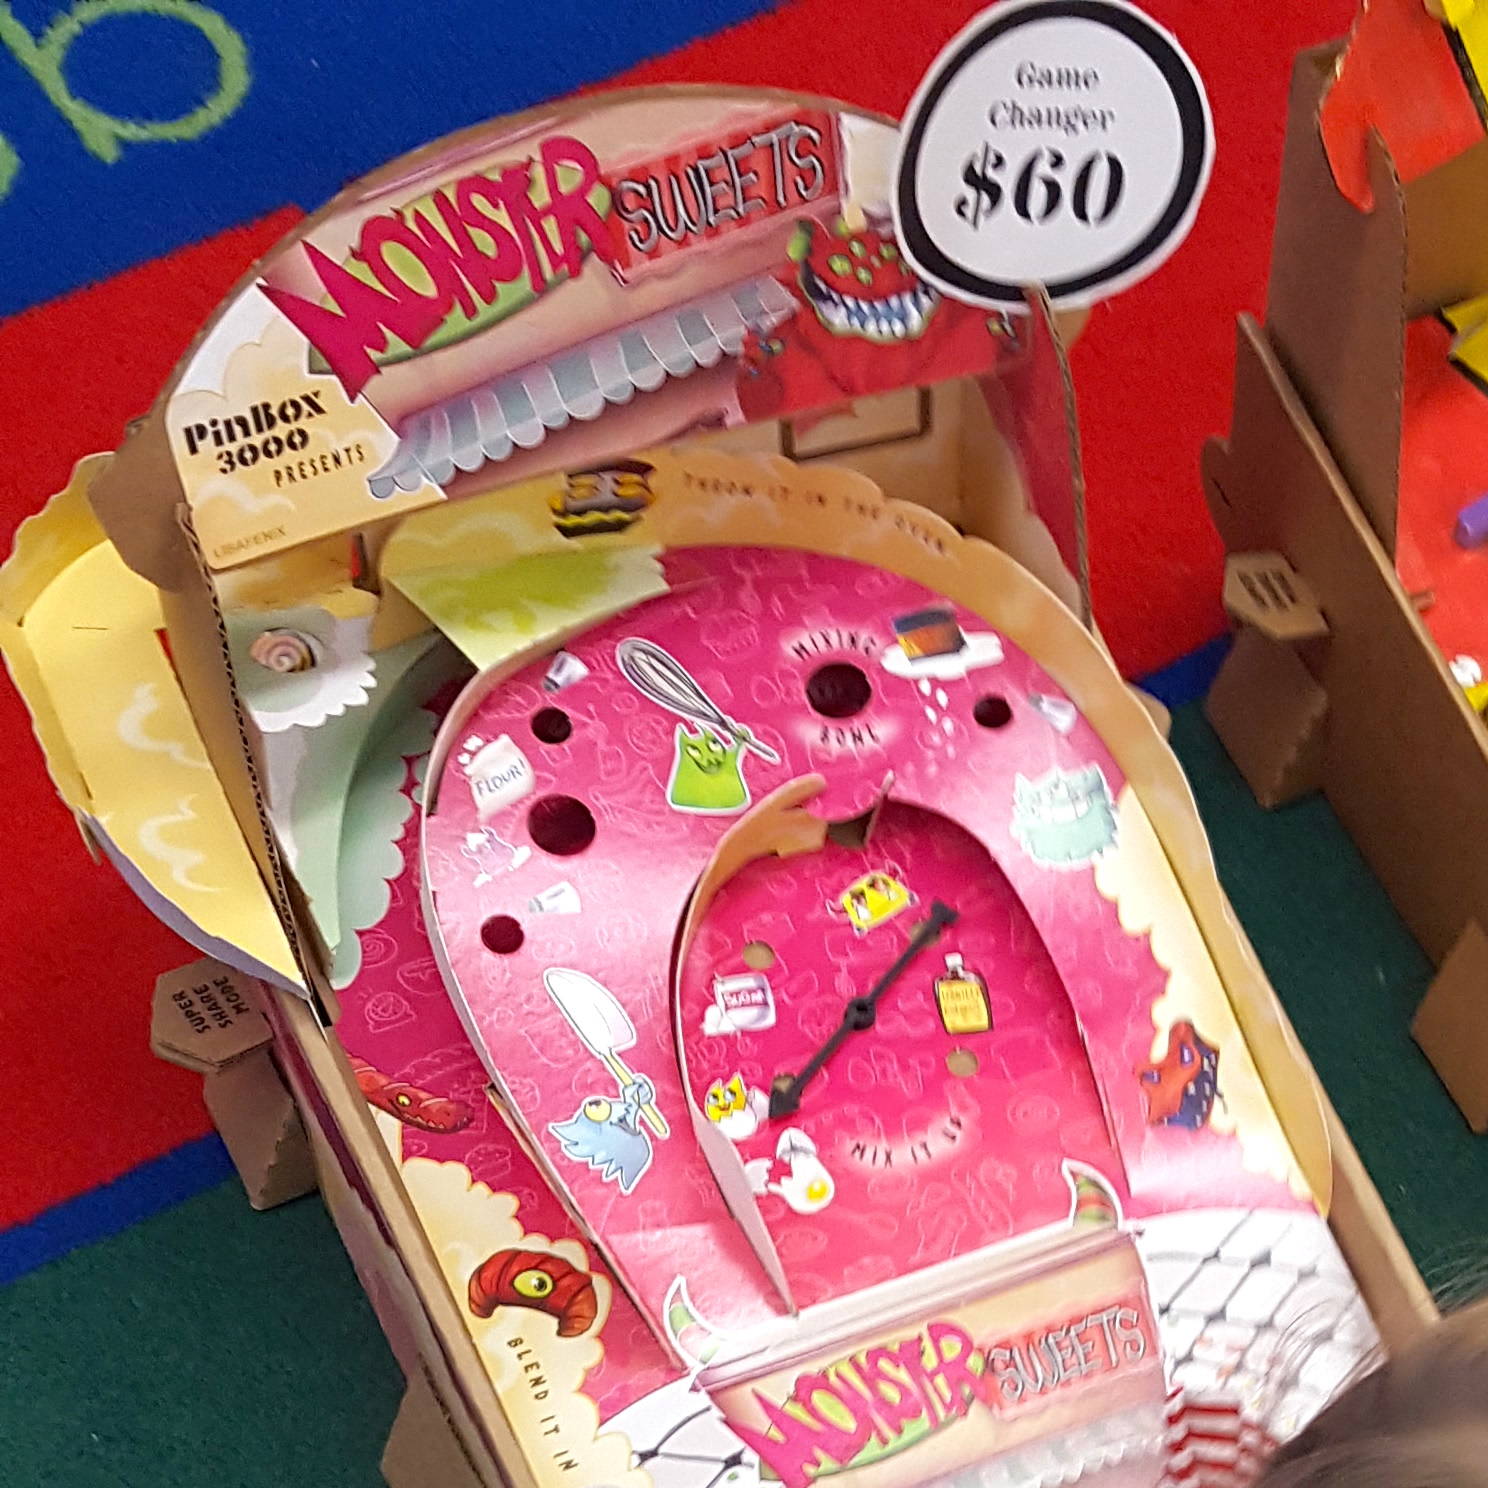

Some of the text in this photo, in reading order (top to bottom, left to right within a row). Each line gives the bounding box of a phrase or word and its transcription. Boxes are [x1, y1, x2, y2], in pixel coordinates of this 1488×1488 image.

[1014, 60, 1101, 90] Game
[986, 99, 1117, 136] Changer
[953, 140, 1127, 231] $60
[256, 120, 826, 403] MONSTER SWEETS
[216, 427, 311, 475] 3000
[273, 443, 366, 488] PRESENTS
[792, 627, 878, 662] MIXING
[820, 724, 882, 747] BOWL
[475, 757, 528, 799] FLOUR!
[172, 989, 212, 1035] SUPER
[192, 983, 234, 1029] SHARE
[212, 975, 250, 1015] MODE
[850, 1115, 963, 1169] MIX IT UP
[985, 1303, 1148, 1401] SWEETS
[506, 1336, 579, 1472] BLEND IT IN
